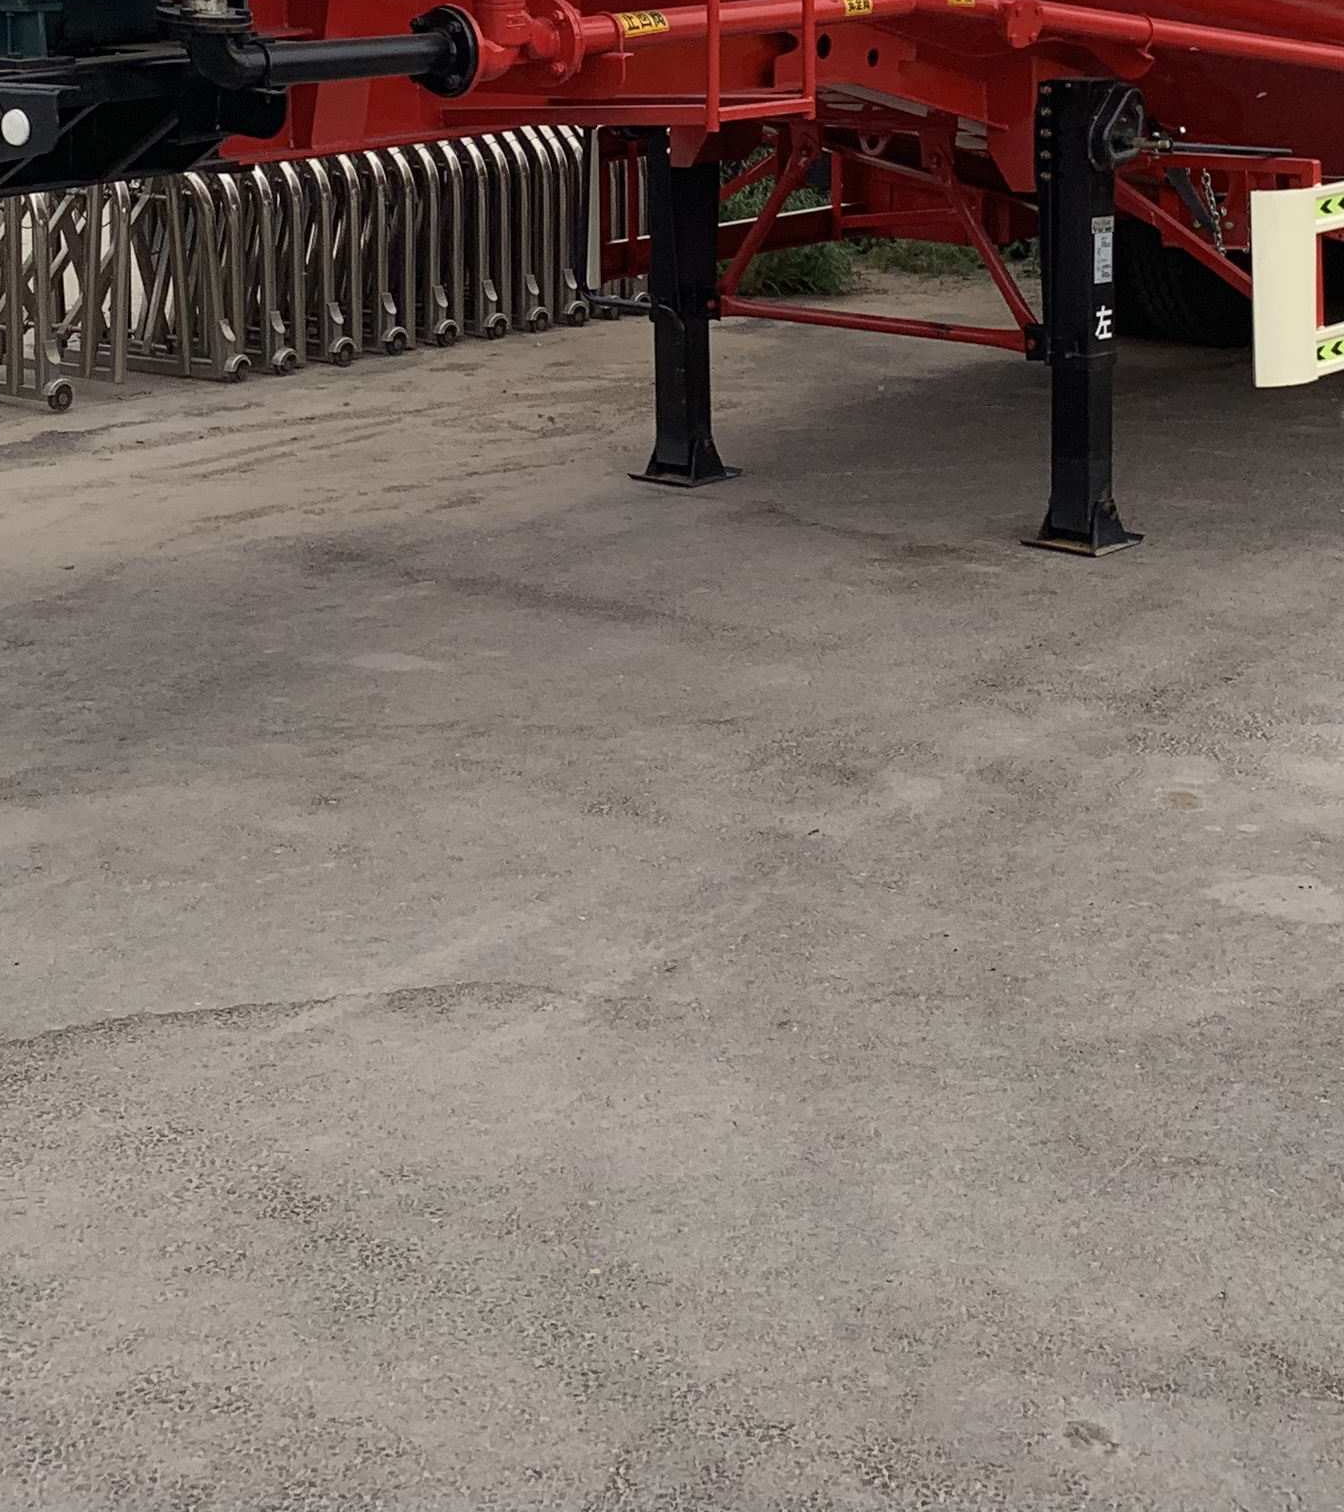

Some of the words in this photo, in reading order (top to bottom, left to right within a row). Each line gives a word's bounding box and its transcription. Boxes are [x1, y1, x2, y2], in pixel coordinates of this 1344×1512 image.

[622, 11, 666, 31] 止回阀
[1095, 305, 1113, 340] 左
